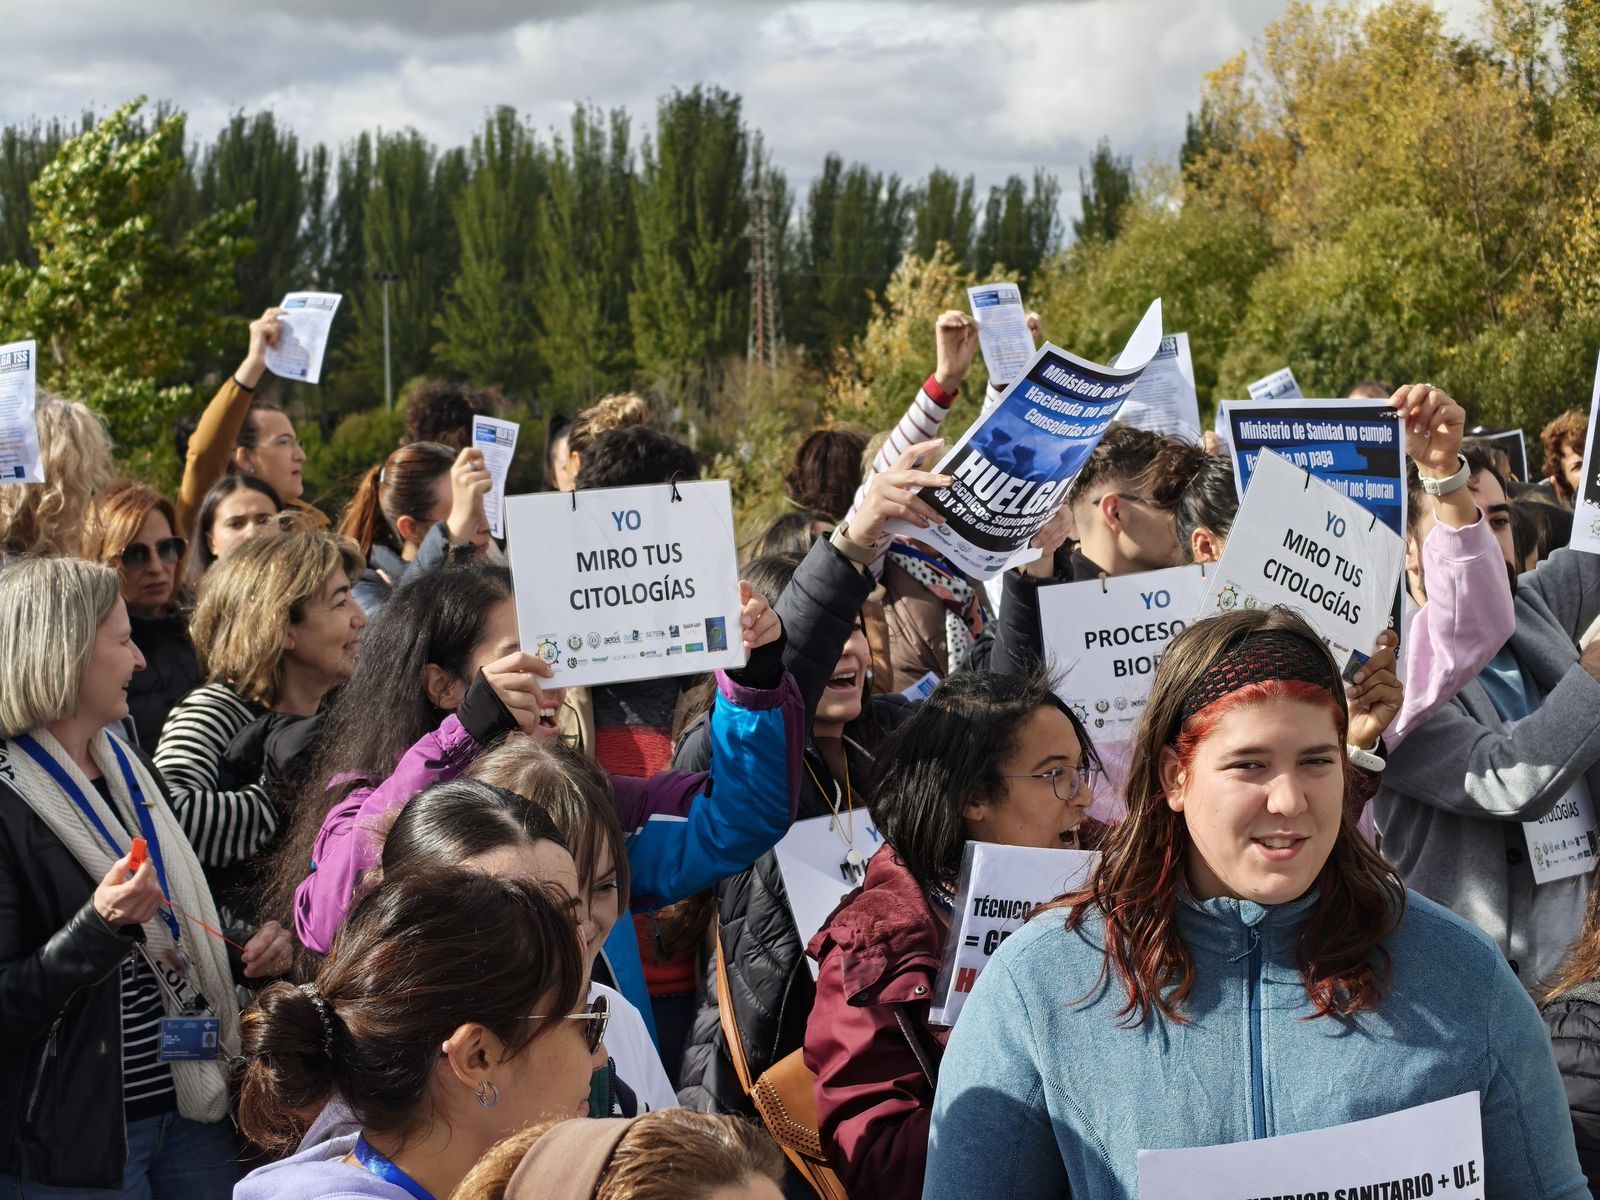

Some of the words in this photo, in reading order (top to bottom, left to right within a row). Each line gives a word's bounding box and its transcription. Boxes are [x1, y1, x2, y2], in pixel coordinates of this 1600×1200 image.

[13, 351, 28, 364] TSS
[1042, 364, 1104, 399] Ministerio
[1100, 385, 1118, 398] de
[1024, 386, 1084, 417] Hacienda
[1081, 406, 1100, 418] no
[1024, 408, 1086, 437] Consejerías
[1239, 421, 1290, 440] Ministerio
[1292, 421, 1305, 439] de
[1306, 421, 1345, 442] Sanidad
[1345, 427, 1356, 441] no
[1359, 425, 1393, 445] cumple
[1294, 452, 1308, 467] no
[1308, 449, 1334, 469] paga
[954, 449, 1073, 515] HUELGA
[1349, 482, 1364, 498] nos
[1365, 479, 1394, 500] ignoran
[951, 475, 992, 521] écnicos
[611, 509, 642, 532] YO
[943, 497, 957, 508] y
[951, 502, 967, 517] 31
[962, 513, 977, 525] de
[975, 522, 1013, 538] octubre
[1325, 510, 1346, 538] YO
[576, 547, 638, 573] MIRO
[642, 542, 683, 566] TUS
[1283, 528, 1331, 568] MIRO
[1333, 555, 1363, 588] TUS
[570, 574, 696, 611] CITOLOGÍAS
[1140, 589, 1171, 610] YO
[1263, 559, 1361, 625] CITOLOGÍAS
[1453, 1160, 1480, 1189] U.E.
